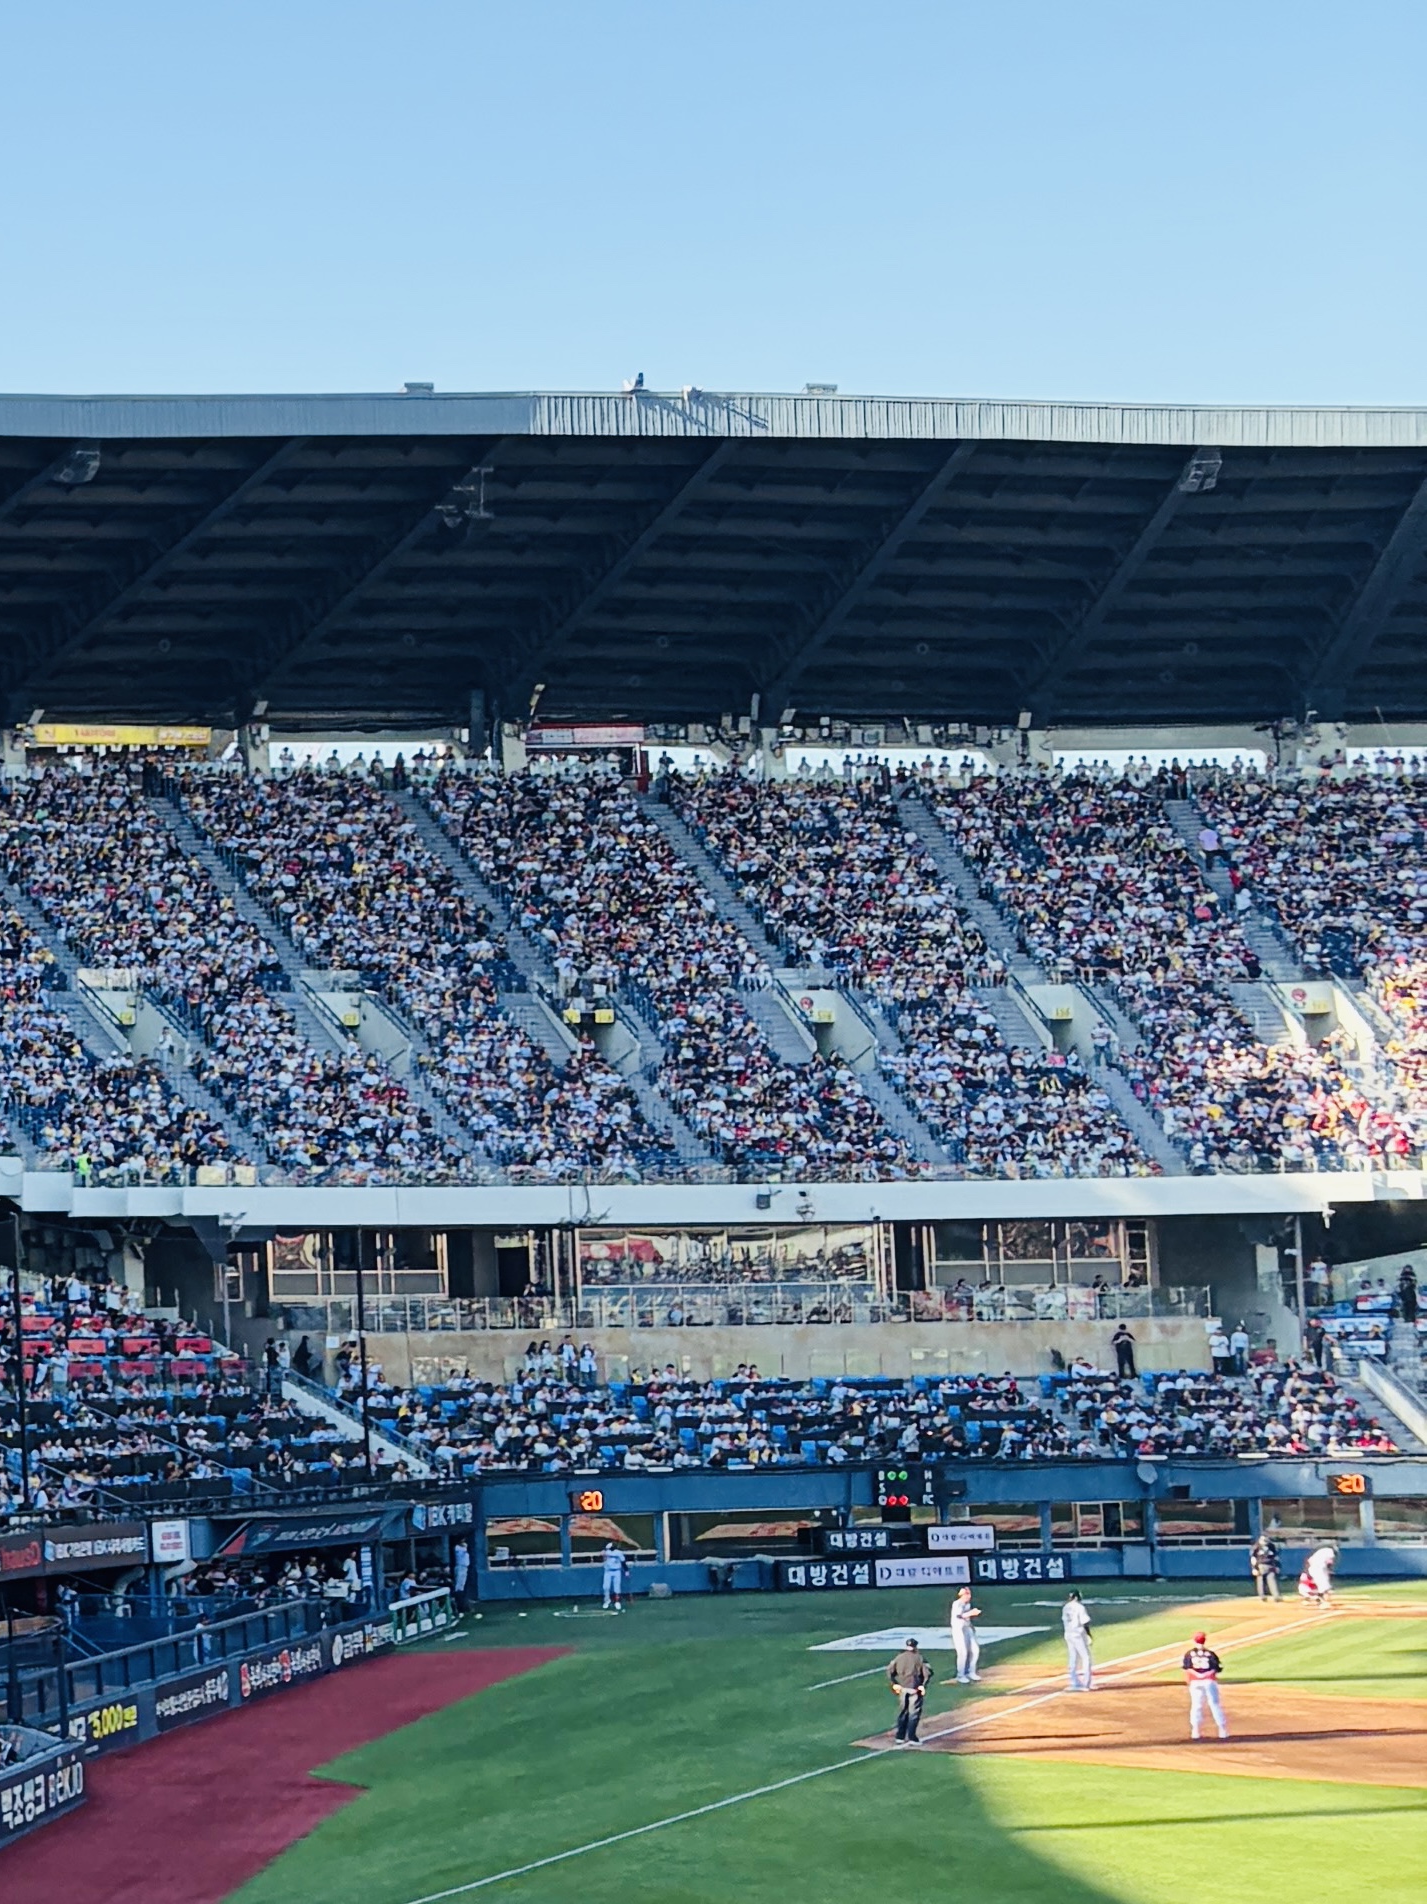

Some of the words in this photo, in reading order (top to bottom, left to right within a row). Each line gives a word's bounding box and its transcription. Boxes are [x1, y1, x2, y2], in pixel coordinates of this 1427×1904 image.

[1337, 1474, 1365, 1493] 20
[580, 1491, 603, 1510] 20
[829, 1531, 887, 1549] 대방건설
[787, 1563, 870, 1588] 대방건설
[978, 1557, 1065, 1580] 대방건설
[1, 1773, 46, 1829] 백조씽크
